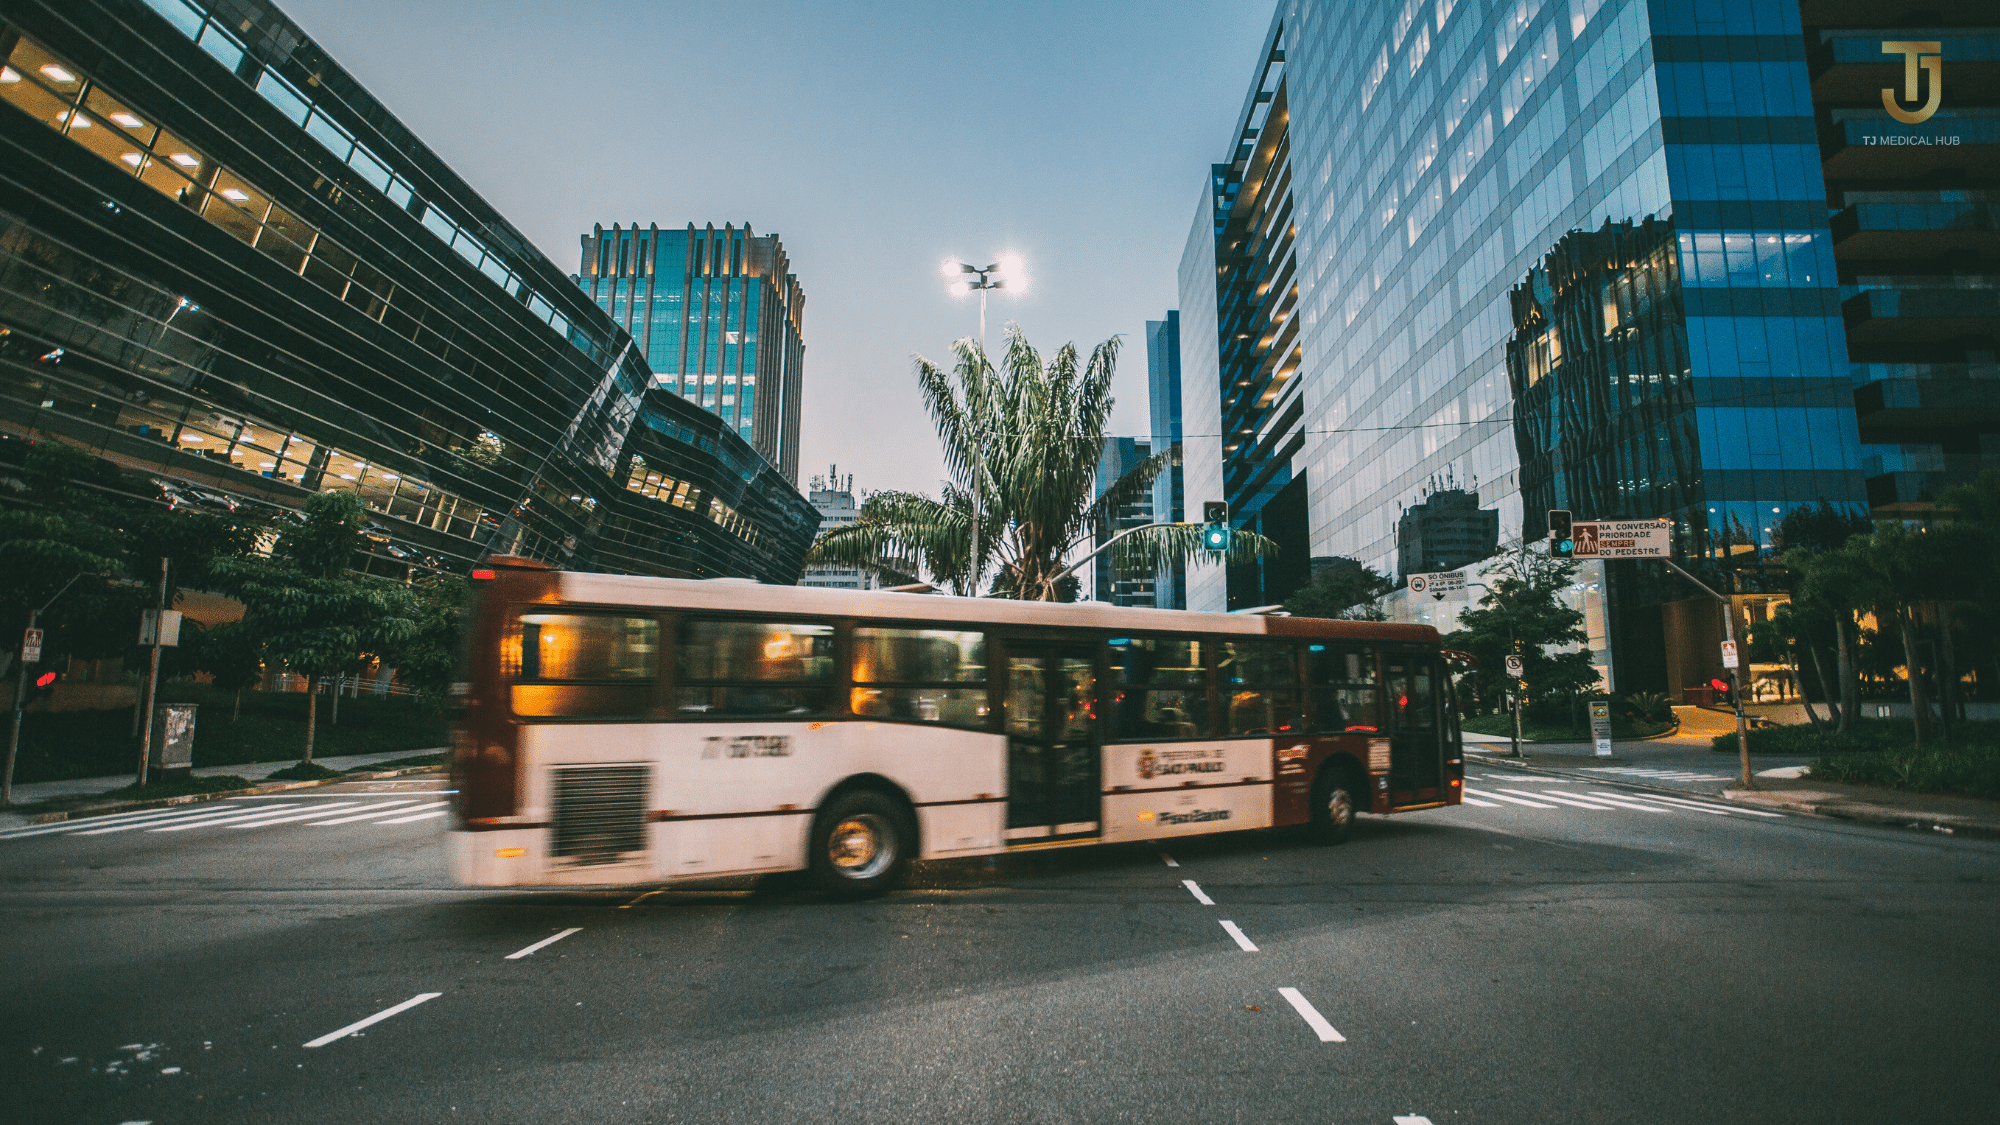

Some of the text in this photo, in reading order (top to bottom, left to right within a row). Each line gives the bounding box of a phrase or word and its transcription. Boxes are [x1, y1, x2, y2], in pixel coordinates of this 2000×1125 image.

[1616, 522, 1667, 530] CONVERSÃO
[1600, 531, 1651, 539] PRIORIDADE
[1616, 547, 1660, 556] PEDESTRE
